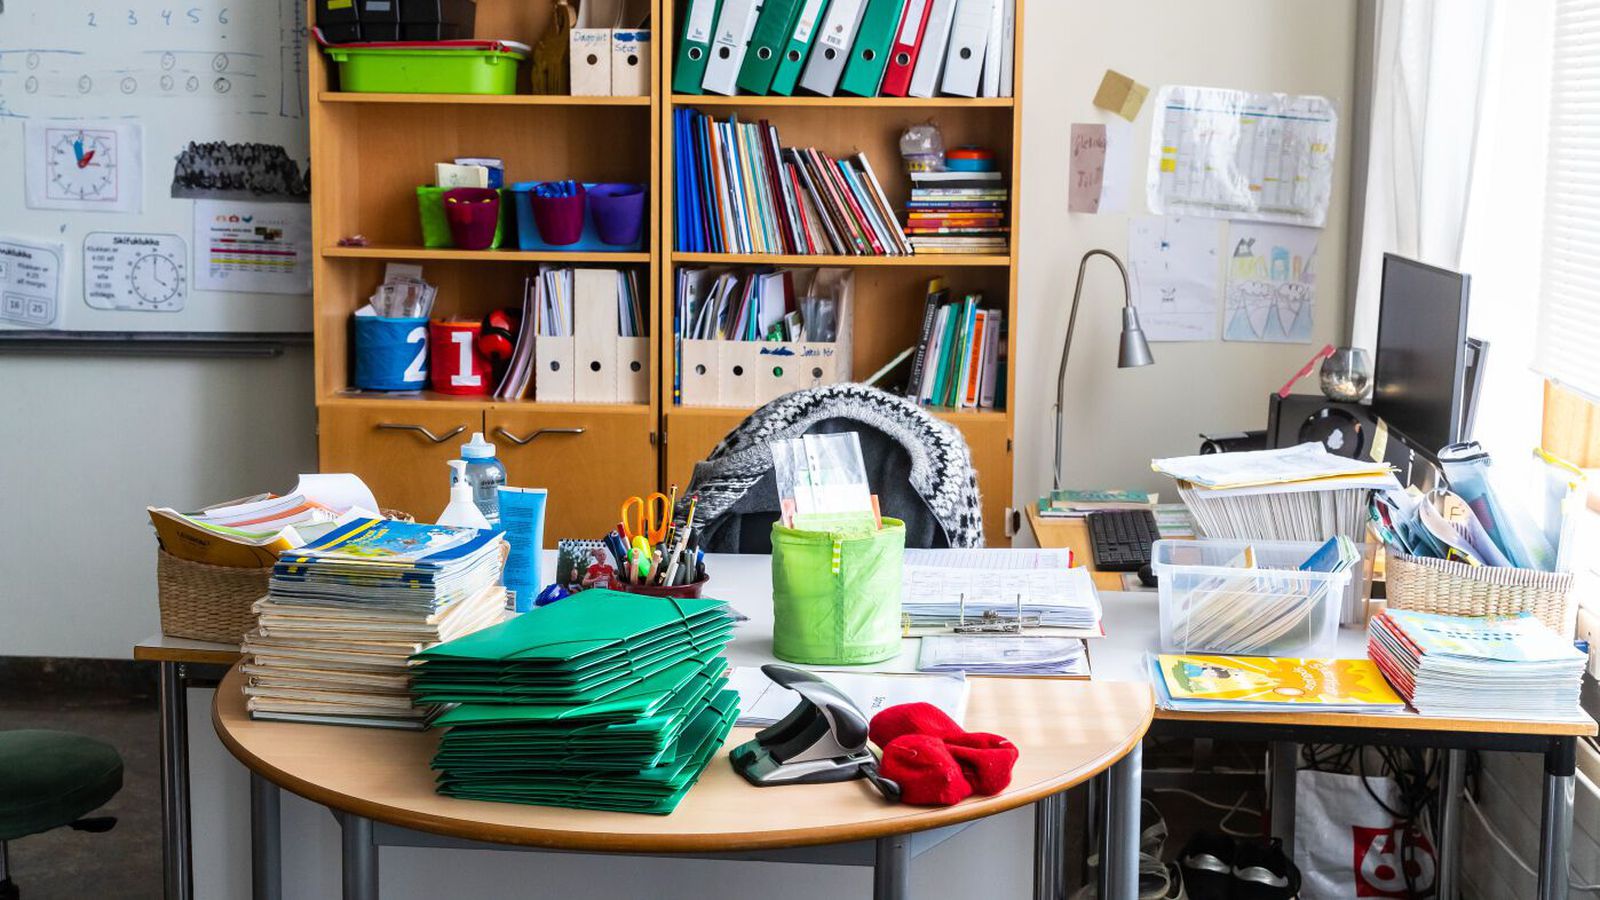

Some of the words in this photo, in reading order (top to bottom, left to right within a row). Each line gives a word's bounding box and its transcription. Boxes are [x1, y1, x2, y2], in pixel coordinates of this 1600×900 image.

[88, 12, 97, 27] 2
[128, 11, 138, 26] 3
[161, 10, 172, 26] 4
[187, 8, 202, 24] 5
[218, 8, 228, 25] 6
[403, 326, 429, 383] 2
[450, 331, 482, 387] 1
